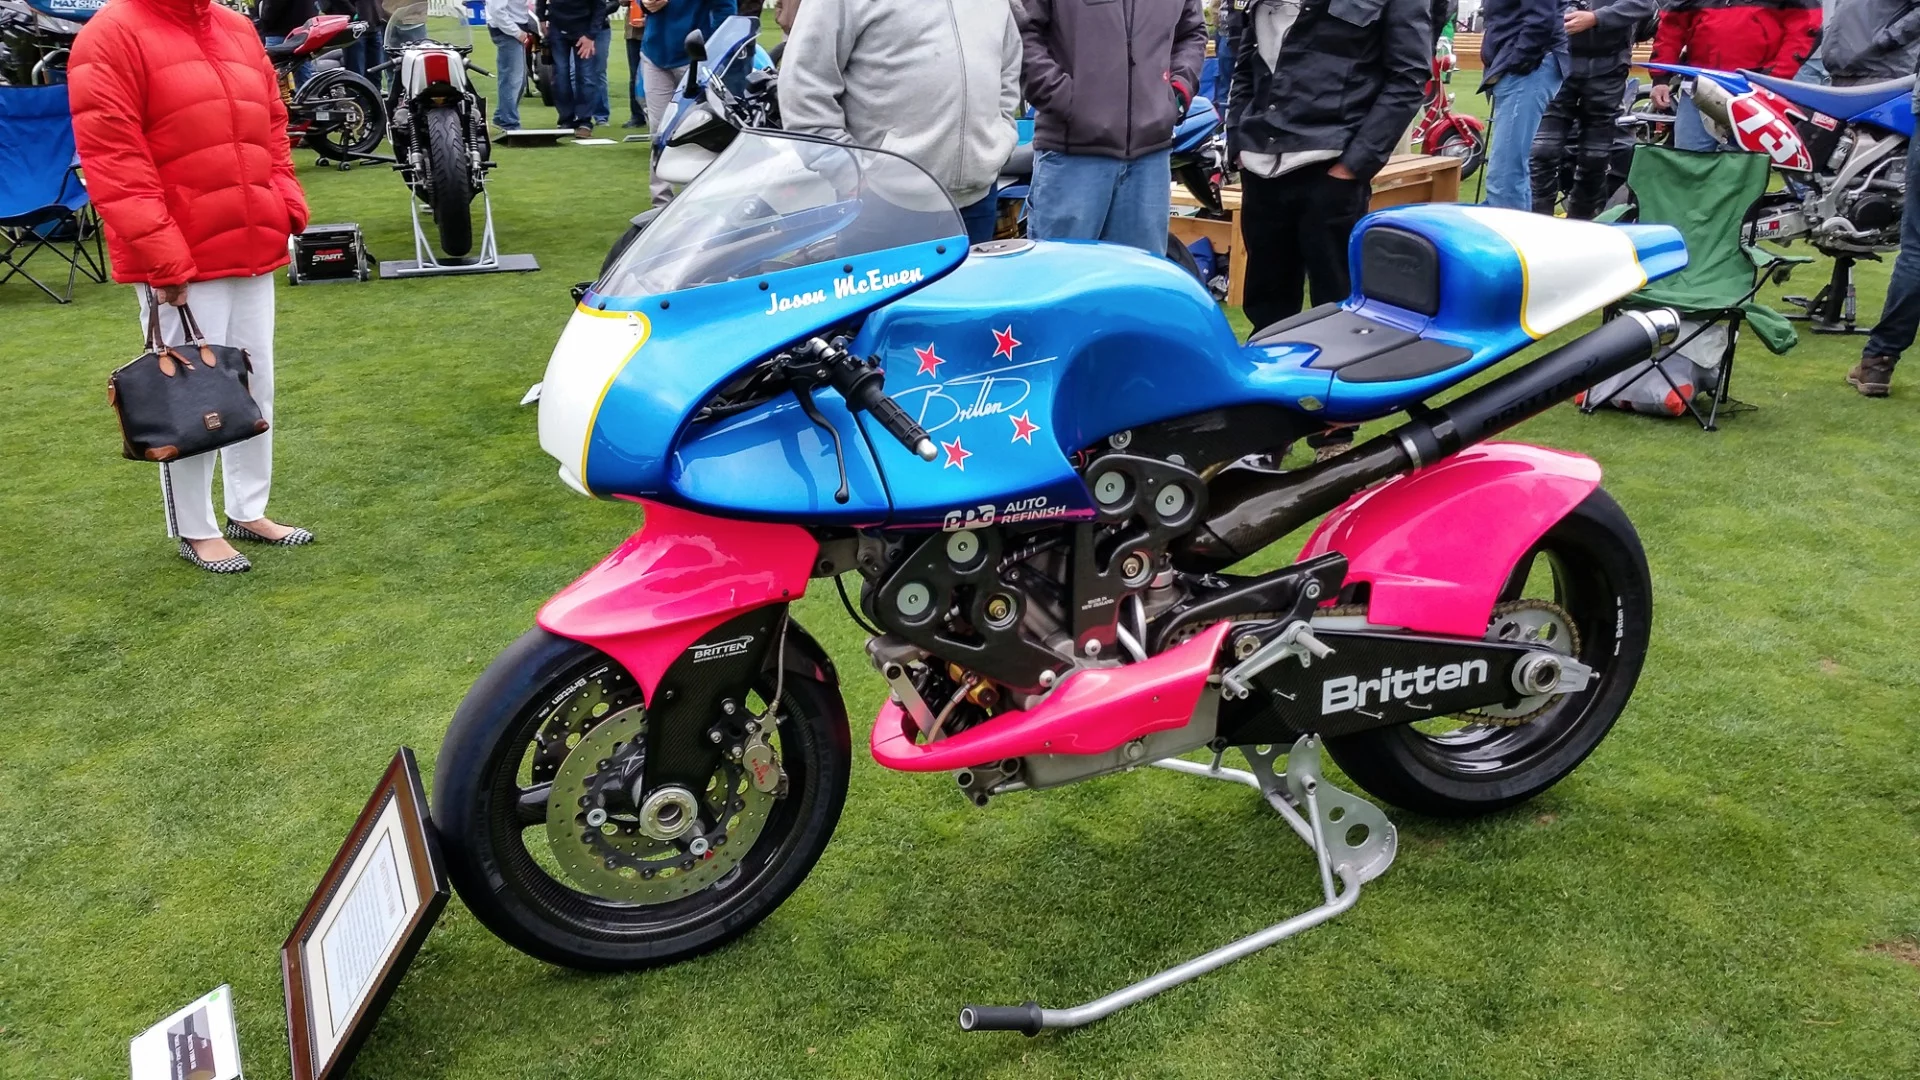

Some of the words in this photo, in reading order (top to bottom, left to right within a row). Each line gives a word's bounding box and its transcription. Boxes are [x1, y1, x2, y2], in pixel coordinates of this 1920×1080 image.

[53, 0, 77, 9] MAX
[78, 0, 107, 9] SHAD
[765, 289, 827, 316] Jason
[833, 267, 924, 300] McEwen
[890, 357, 1058, 433] Britten
[1001, 505, 1066, 524] REFINISH
[1003, 496, 1048, 514] AUTO
[694, 641, 748, 659] BRITTEN
[551, 677, 588, 705] Britten
[1321, 659, 1488, 716] Britten
